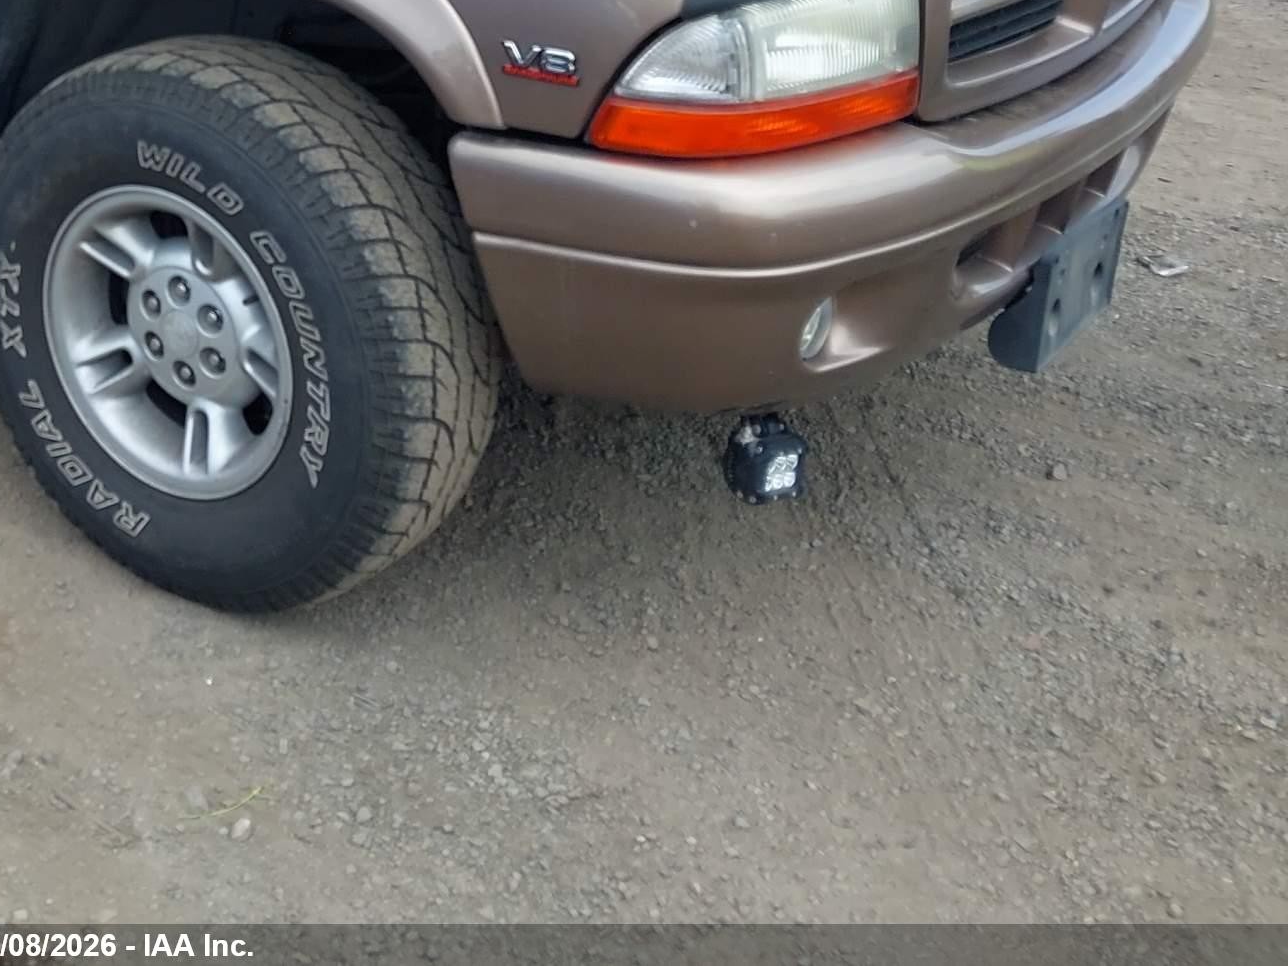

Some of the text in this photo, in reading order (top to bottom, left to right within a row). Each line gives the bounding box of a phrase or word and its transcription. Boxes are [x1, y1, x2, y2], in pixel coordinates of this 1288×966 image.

[503, 40, 577, 75] V8
[137, 140, 331, 489] WILD COUNTRY
[19, 379, 151, 538] RADIAL
